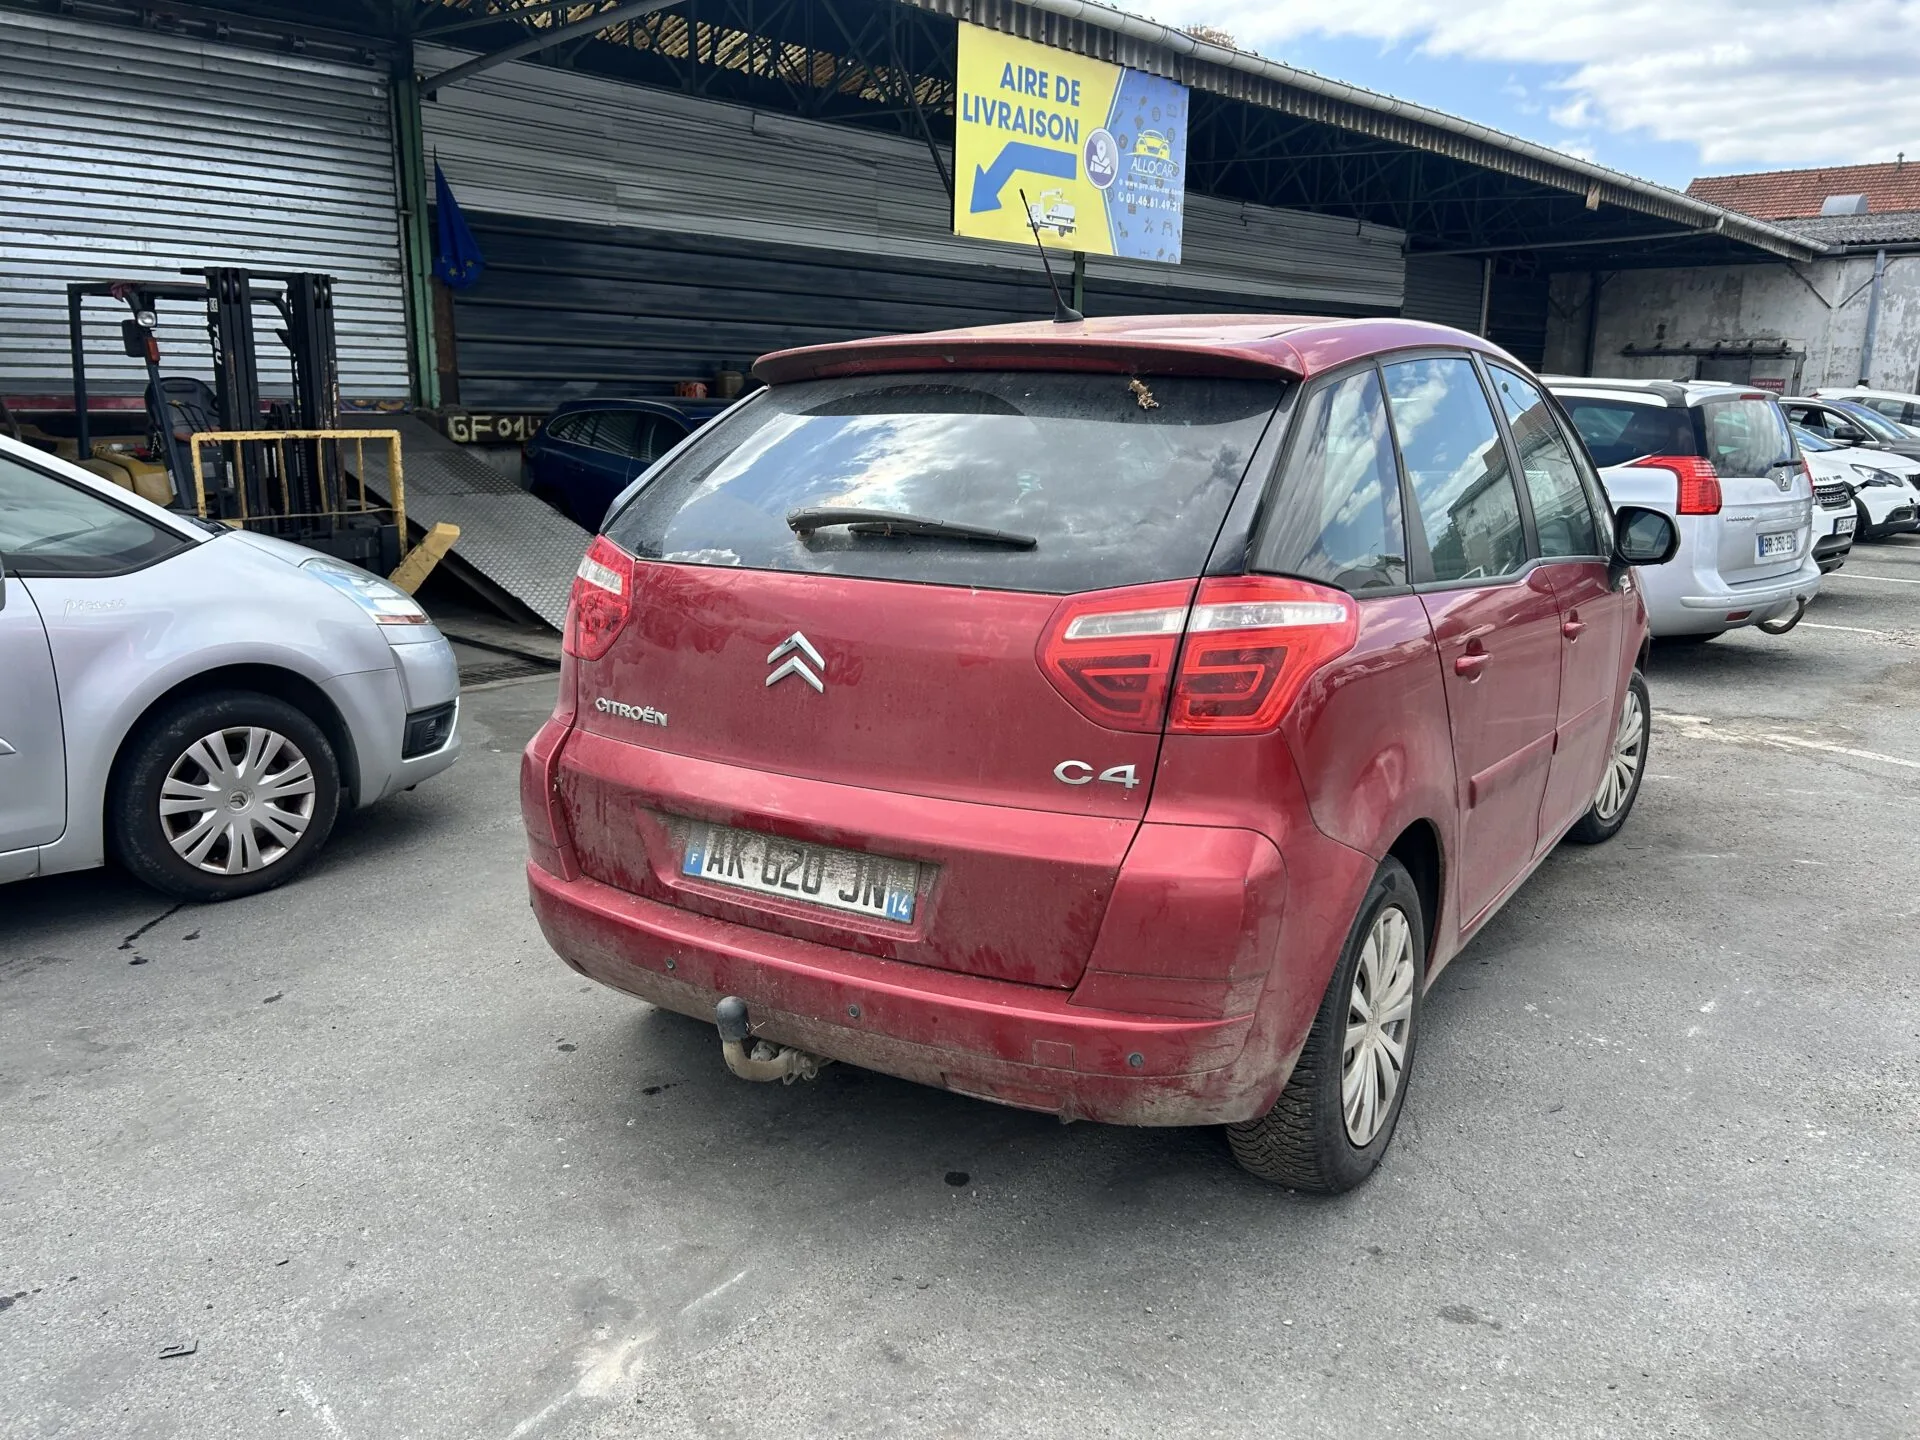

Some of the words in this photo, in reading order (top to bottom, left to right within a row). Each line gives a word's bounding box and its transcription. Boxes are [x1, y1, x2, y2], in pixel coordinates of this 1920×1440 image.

[1000, 62, 1048, 99] AIRE
[1055, 74, 1081, 107] DE
[963, 92, 1079, 145] LIVRAISON
[1130, 157, 1174, 178] ALLOCAR
[447, 415, 493, 442] GF
[595, 697, 668, 727] CITROËN
[890, 891, 909, 916] 14
